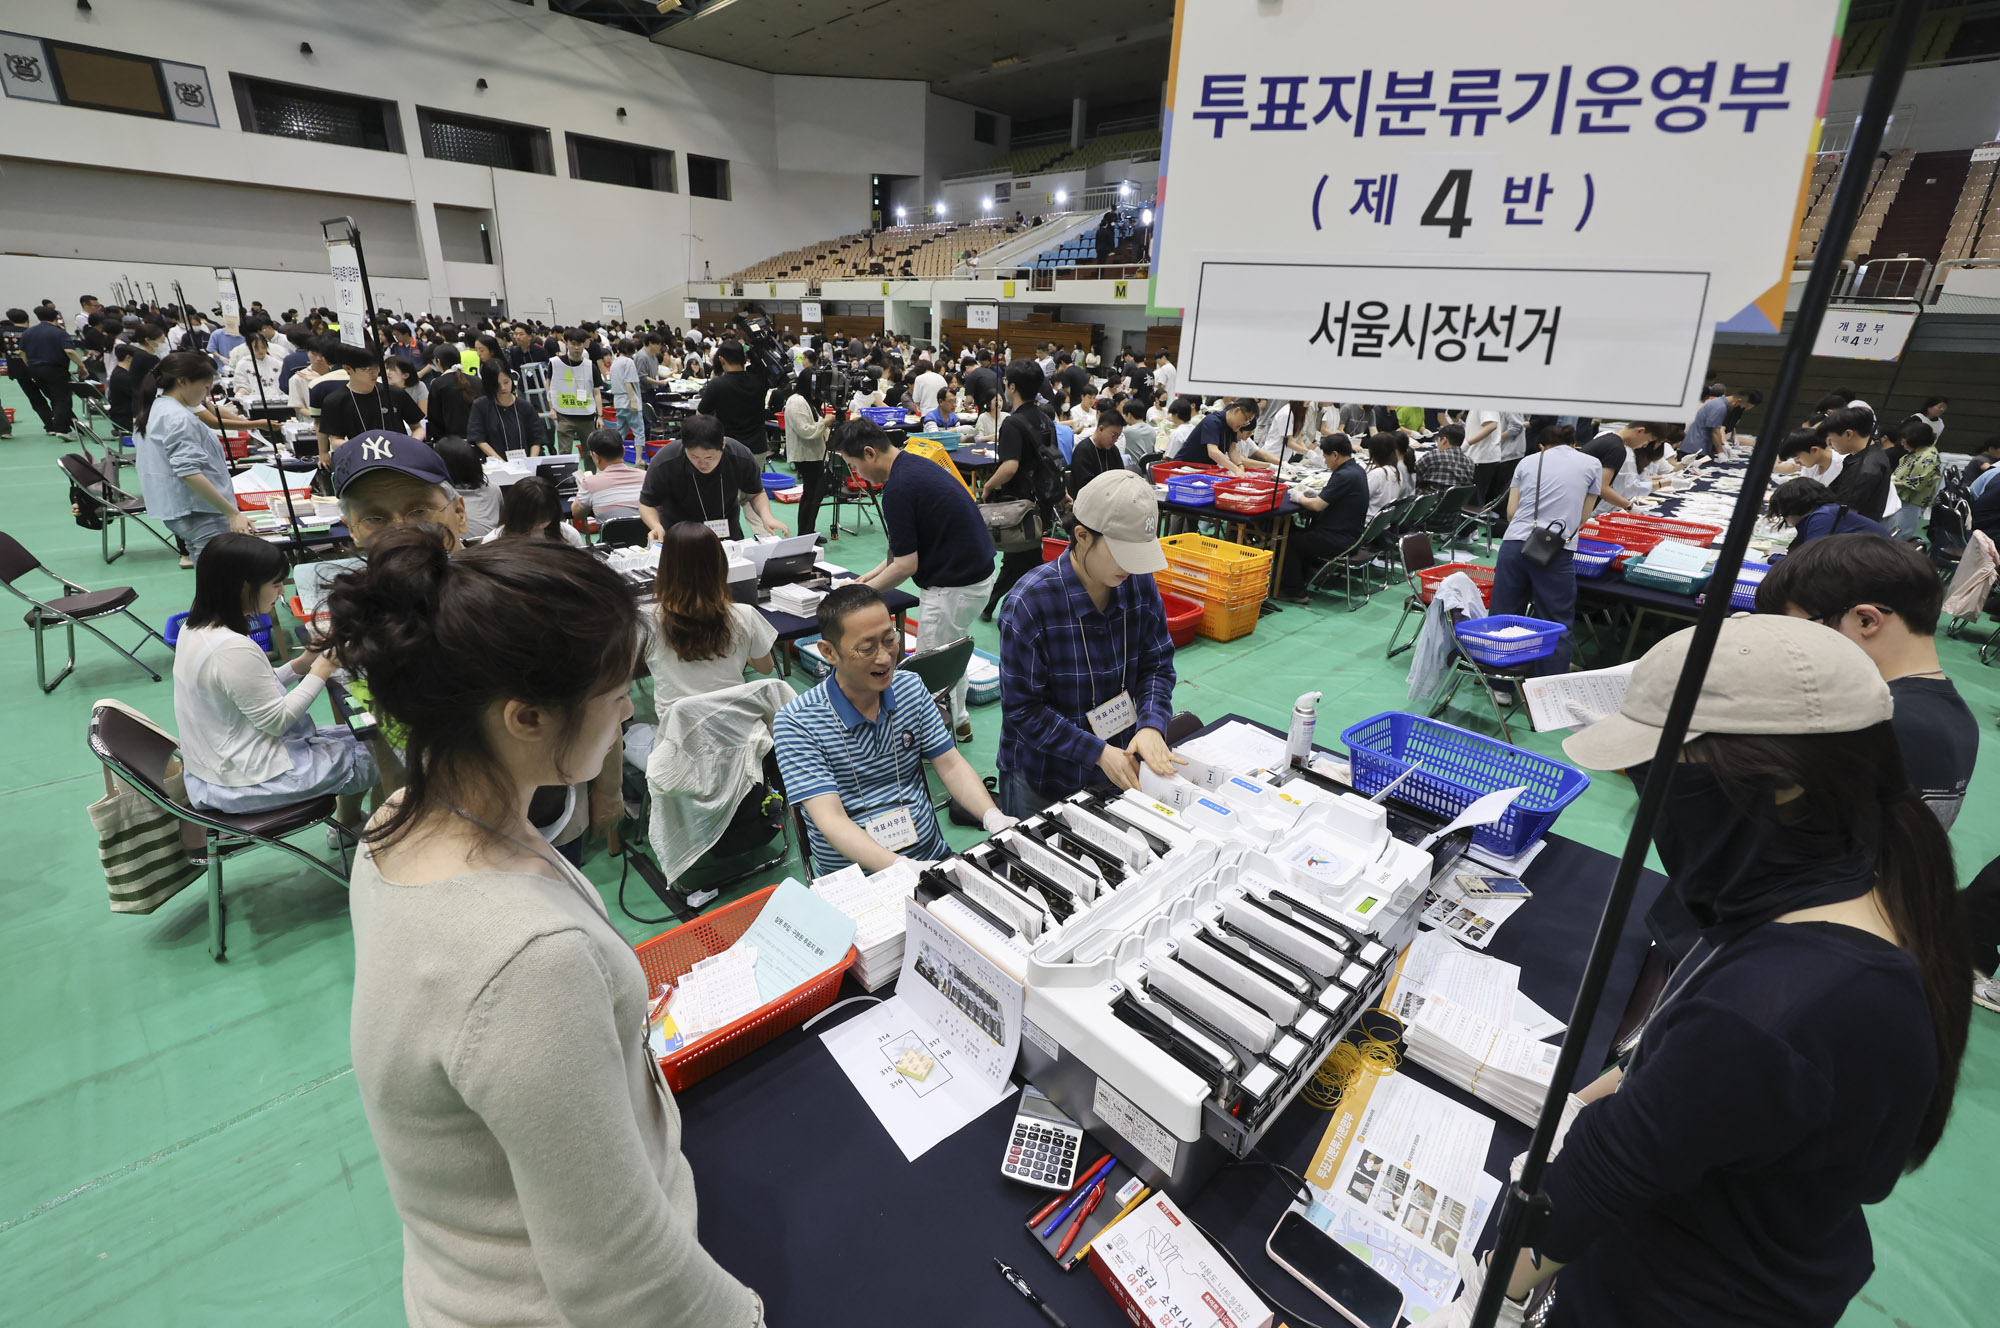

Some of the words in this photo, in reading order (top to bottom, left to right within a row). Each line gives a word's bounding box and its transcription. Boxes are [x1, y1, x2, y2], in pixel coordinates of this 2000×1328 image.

[1192, 61, 1791, 138] 투표지분류기운영부
[1115, 285, 1126, 297] M
[1309, 301, 1562, 366] 서울시장선거
[361, 435, 394, 461] NY
[1144, 516, 1155, 532] NY
[1094, 700, 1128, 722] 개표사무원
[872, 816, 907, 833] 개표사무원
[803, 936, 816, 952] 투표지
[1110, 984, 1122, 993] 12
[878, 1033, 890, 1043] 314
[928, 1038, 941, 1048] 317
[938, 1049, 952, 1060] 318
[880, 1066, 893, 1076] 315
[890, 1078, 904, 1089] 316
[1316, 1112, 1355, 1180] 투표지분류기운영부
[1127, 1273, 1157, 1309] 여유분
[1136, 1265, 1158, 1289] 장갑
[1158, 1295, 1192, 1328] 소진시
[1198, 1260, 1218, 1283] 다용도
[1218, 1282, 1250, 1320] 니트릴장갑
[1204, 1295, 1219, 1310] 화이트
